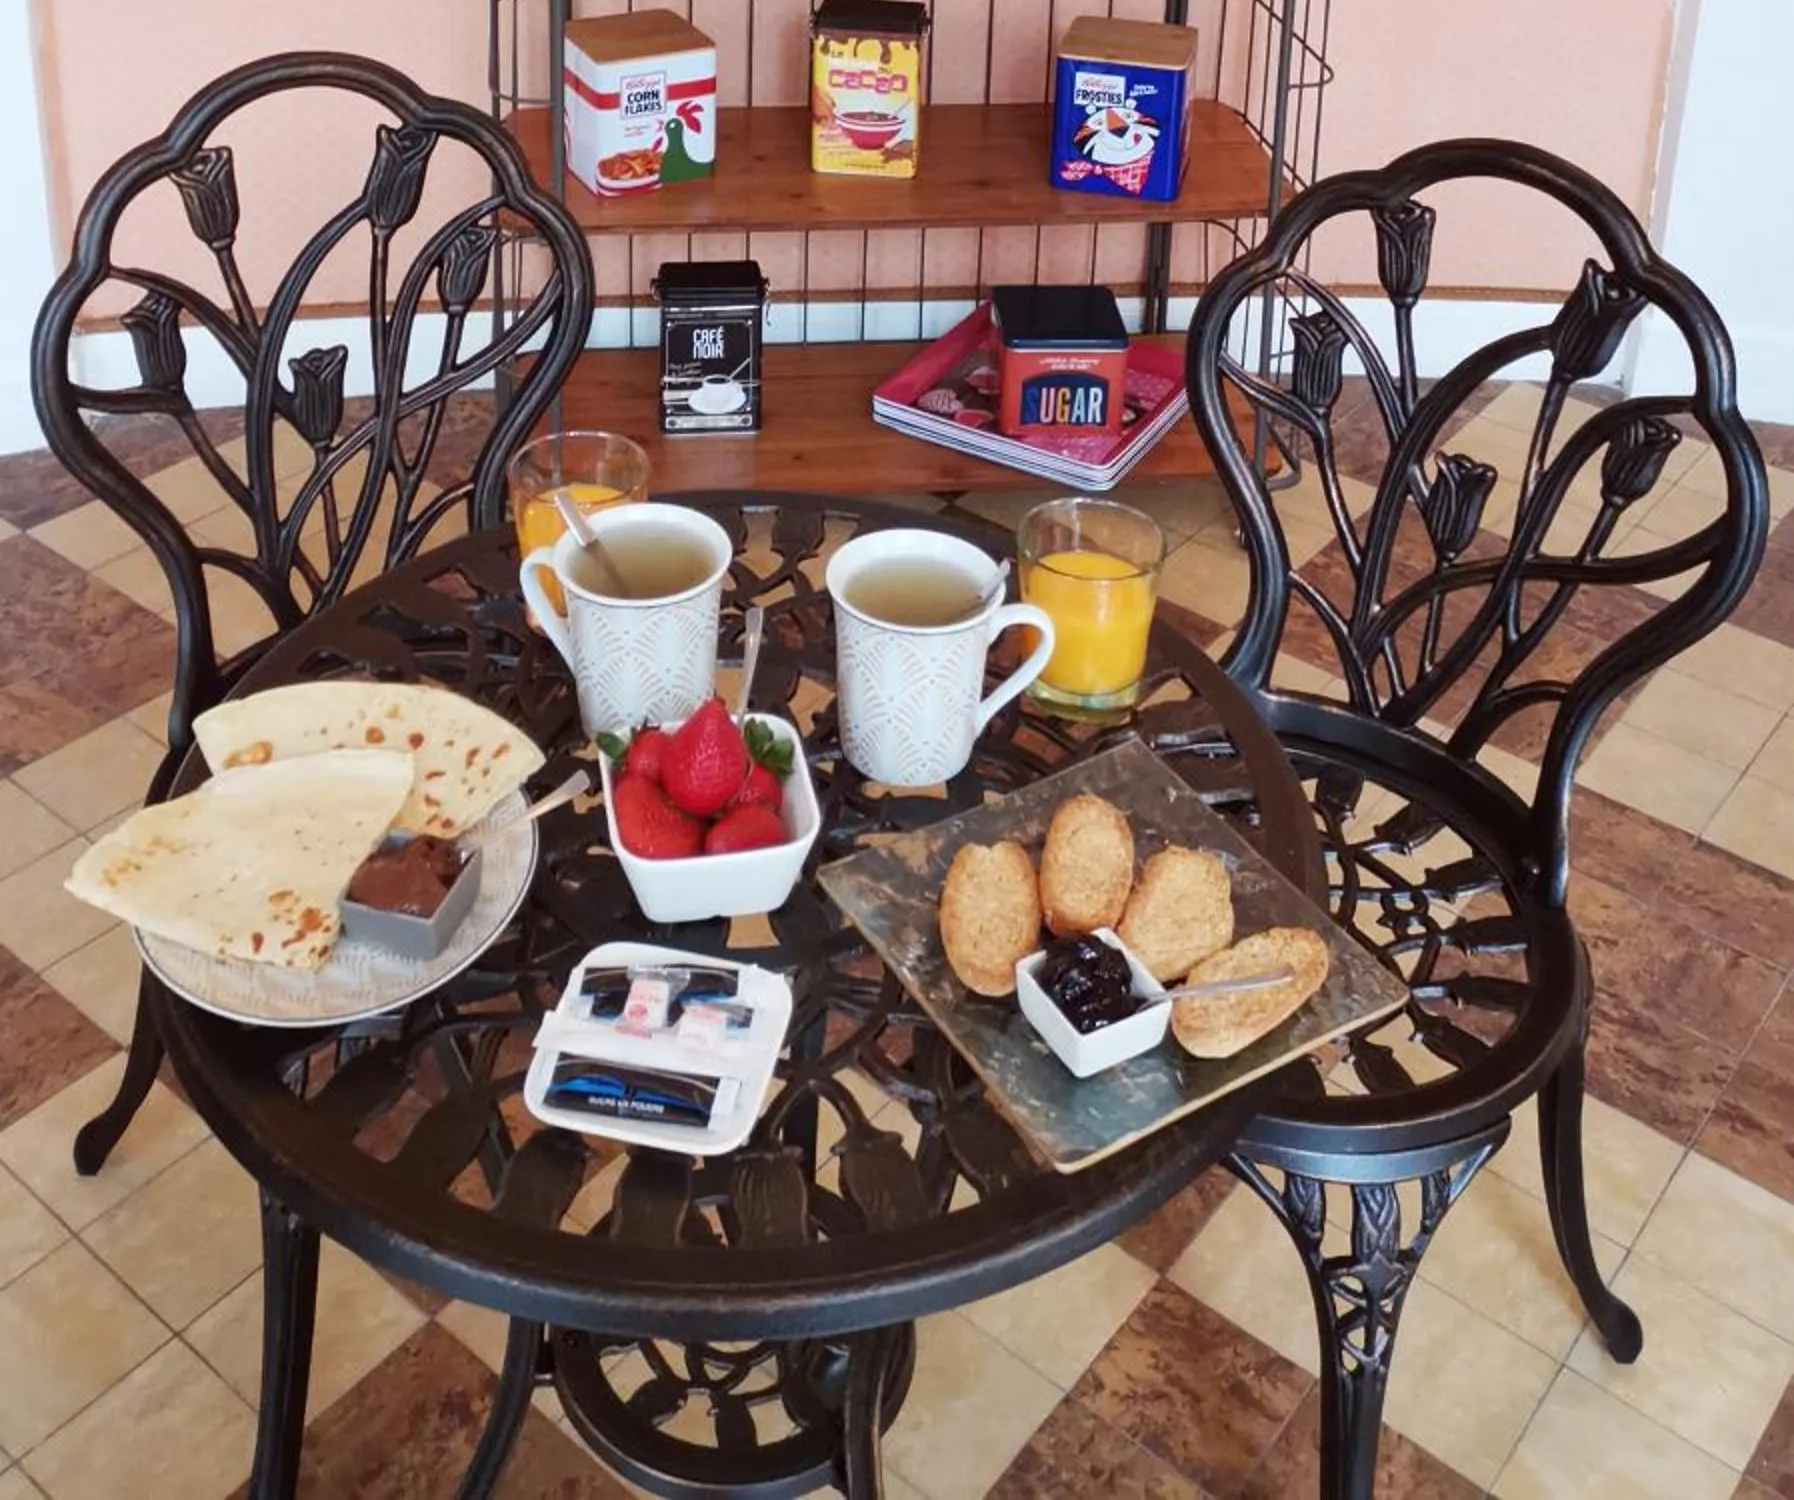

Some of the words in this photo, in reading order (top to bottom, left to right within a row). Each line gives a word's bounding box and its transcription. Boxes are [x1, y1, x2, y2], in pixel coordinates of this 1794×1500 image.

[627, 89, 660, 105] CORN
[693, 325, 725, 343] CAFÉ
[693, 341, 725, 360] NOIR
[1024, 386, 1104, 424] SUGAR
